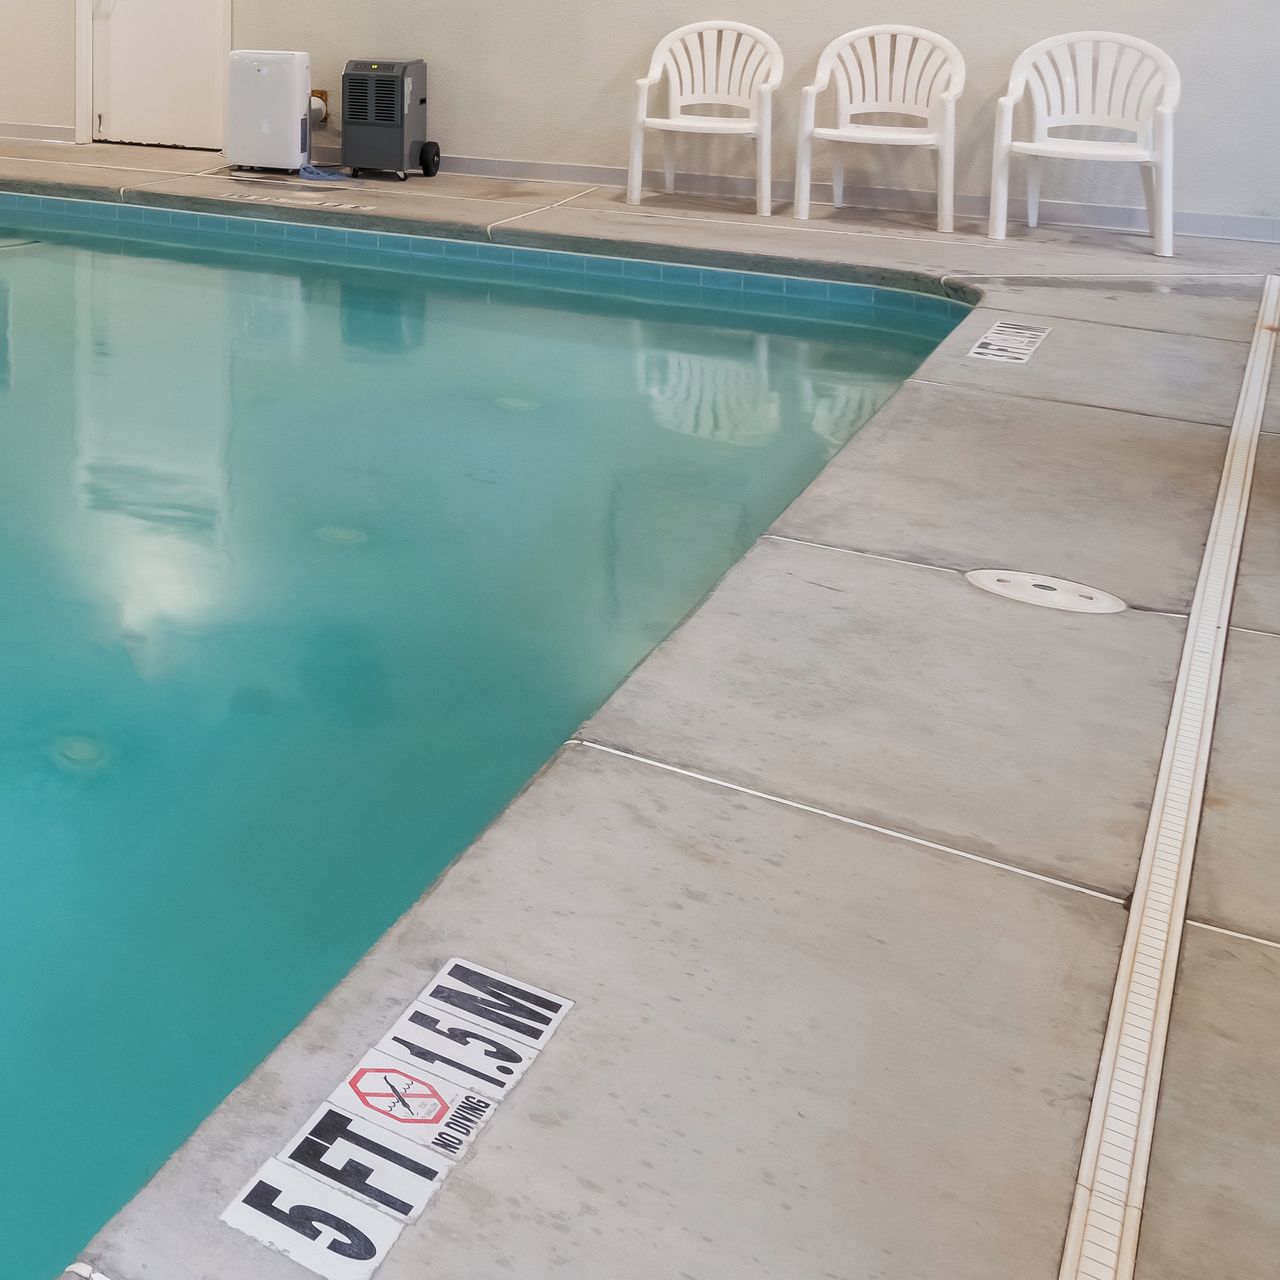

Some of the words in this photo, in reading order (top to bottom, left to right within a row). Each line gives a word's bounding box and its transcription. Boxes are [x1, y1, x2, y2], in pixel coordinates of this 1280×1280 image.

[429, 962, 564, 1041] M
[391, 1010, 523, 1089] 1.5
[431, 1131, 464, 1154] NO
[443, 1094, 490, 1137] DIVING
[289, 1109, 439, 1217] FT
[242, 1179, 377, 1261] 5
